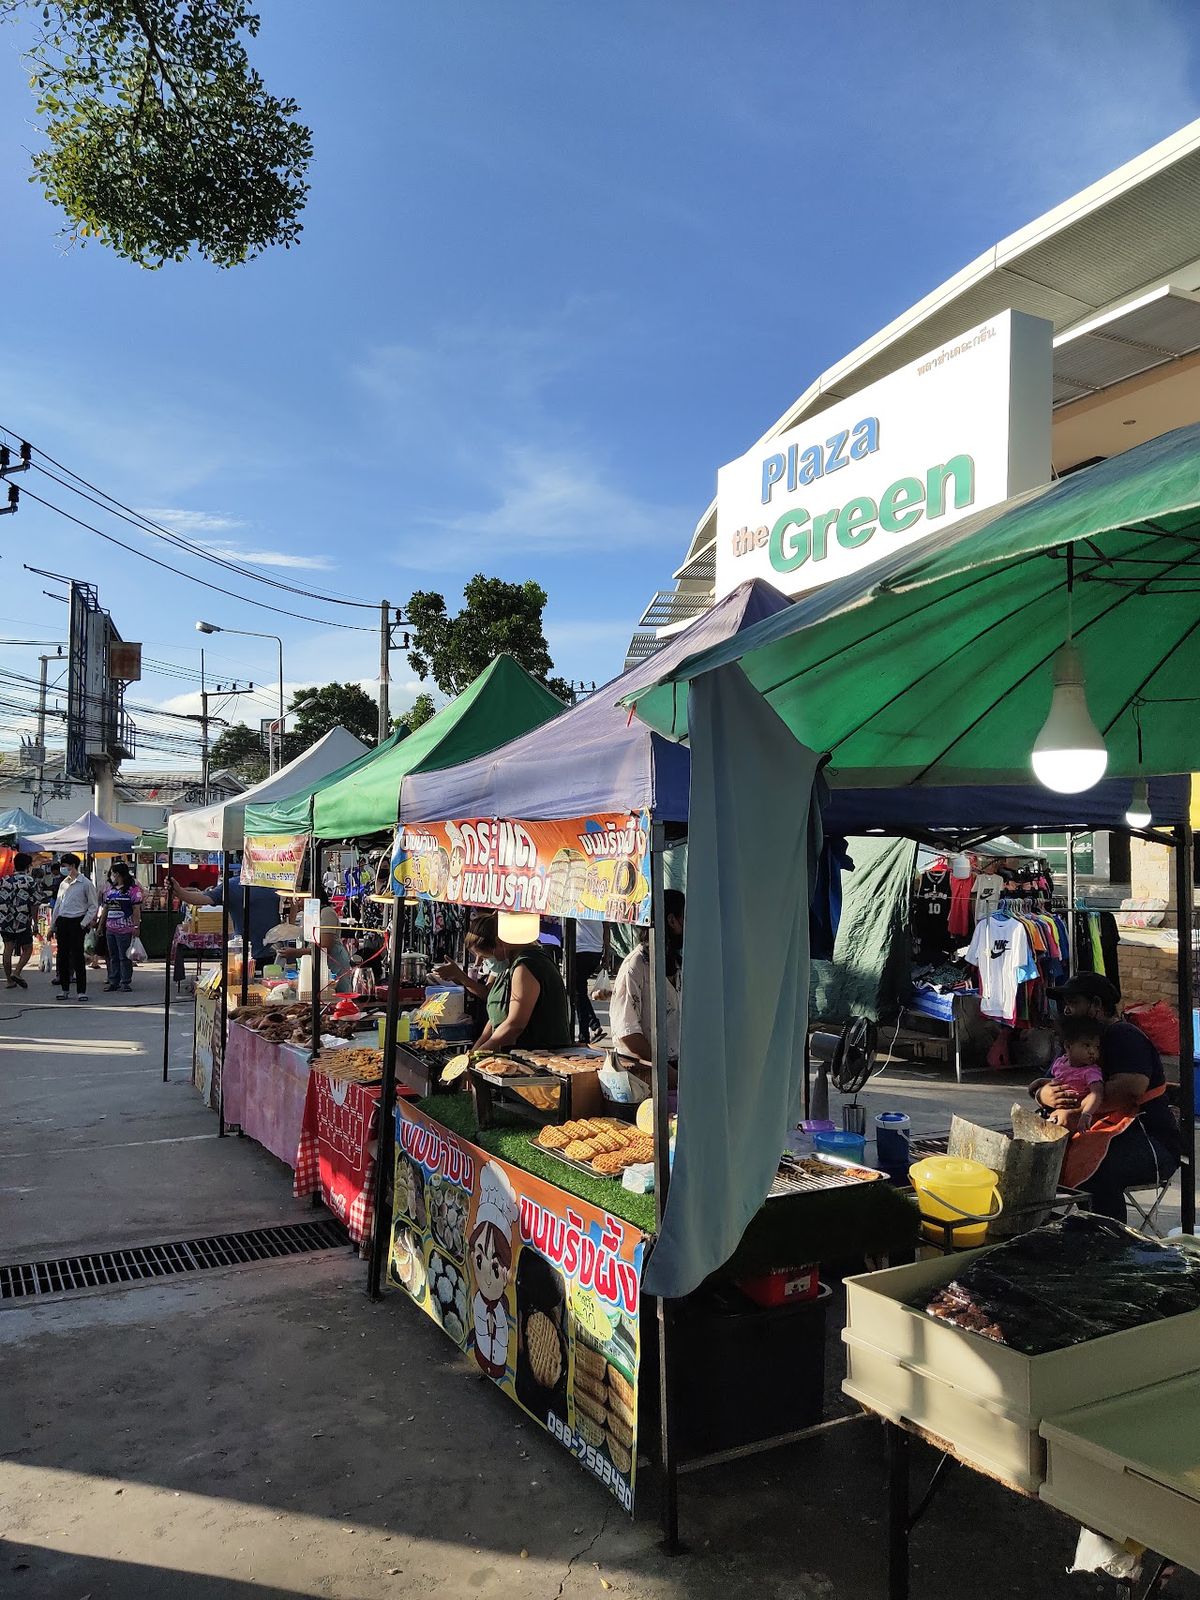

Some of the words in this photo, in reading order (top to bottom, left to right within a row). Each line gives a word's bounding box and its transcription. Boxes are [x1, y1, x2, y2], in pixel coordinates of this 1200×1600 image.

[761, 416, 880, 504] Plaza
[732, 525, 769, 557] the
[769, 454, 975, 574] Green
[462, 858, 551, 910] ขนมโบราณ
[928, 902, 941, 915] 10
[520, 1195, 639, 1315] ขนมรังผึ้ง
[547, 1410, 632, 1512] 098-7593430
